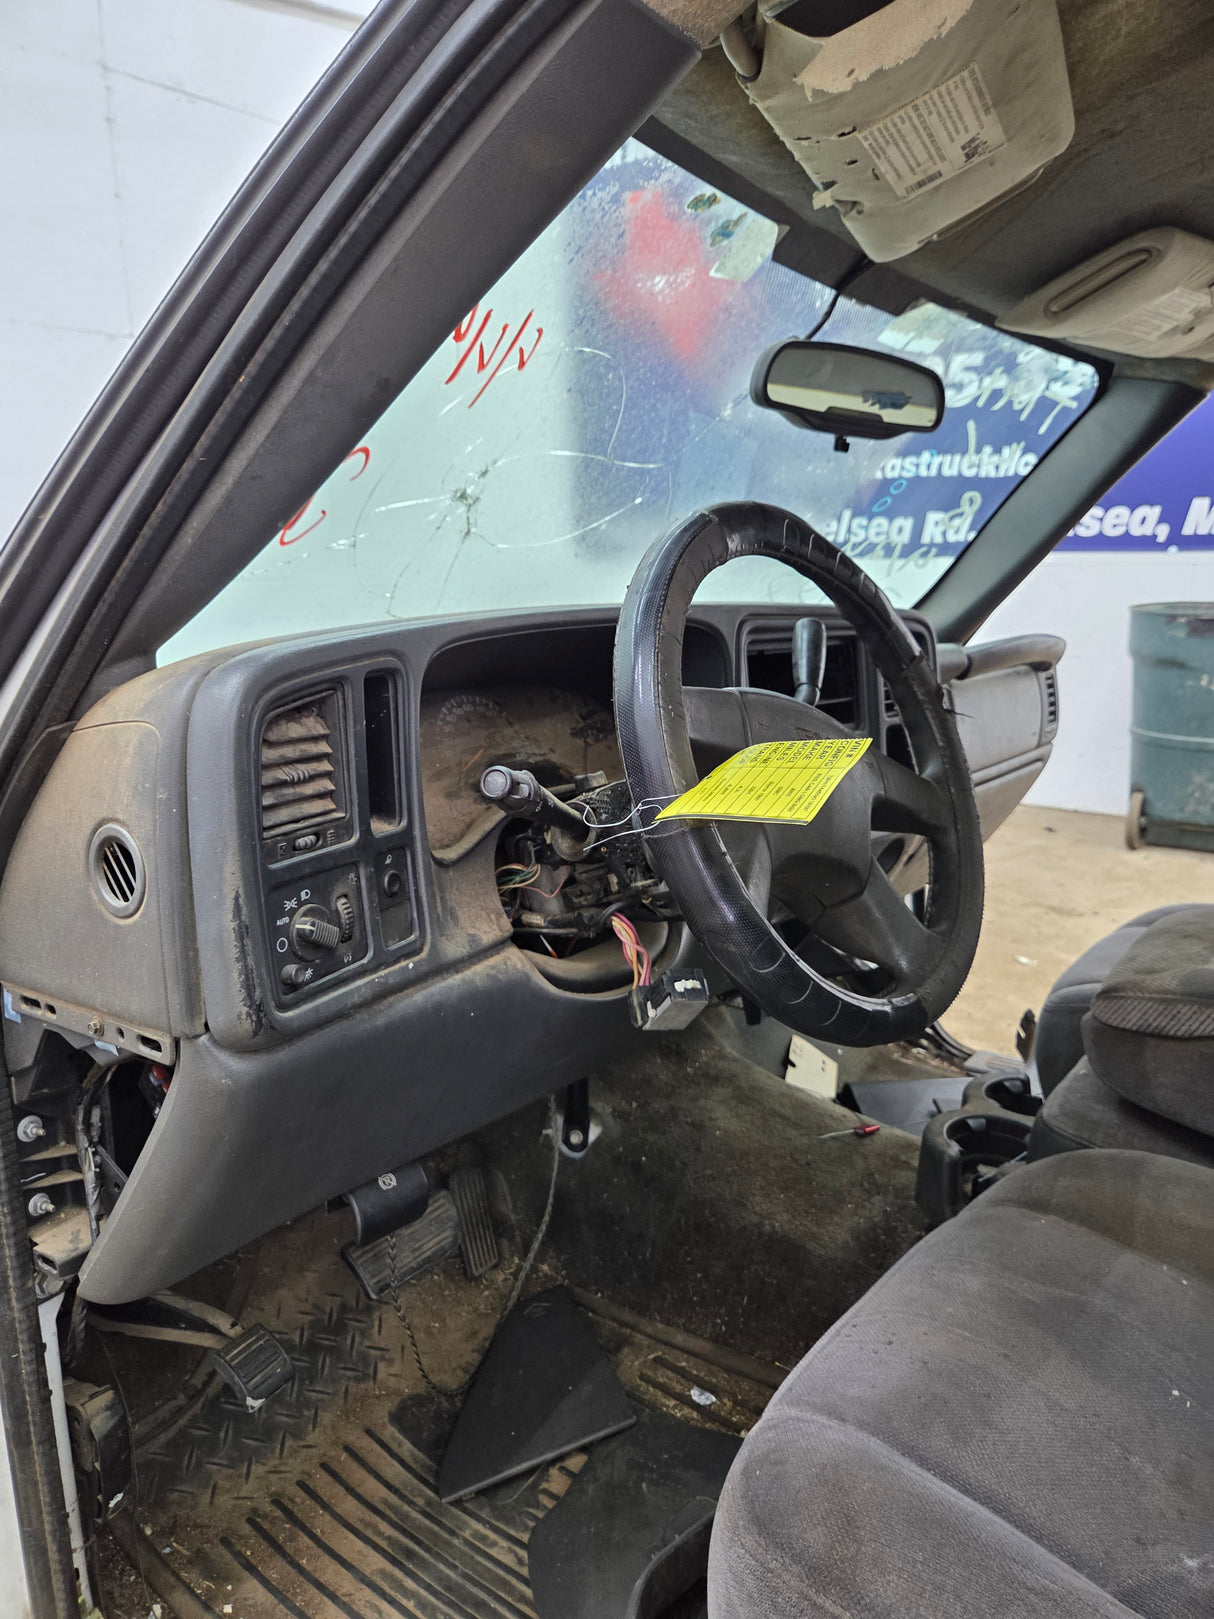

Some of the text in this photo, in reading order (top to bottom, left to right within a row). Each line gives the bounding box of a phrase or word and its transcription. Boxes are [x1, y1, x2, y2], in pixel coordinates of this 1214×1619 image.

[1066, 505, 1171, 543] sea,
[750, 743, 772, 763] TRANS
[760, 742, 784, 766] ENGINE
[776, 742, 796, 761] MILES
[787, 742, 809, 764] MODEL
[803, 741, 822, 761] MAKE
[818, 740, 835, 760] YEAR
[824, 740, 849, 767] CONFIG
[276, 916, 289, 926] AUTO
